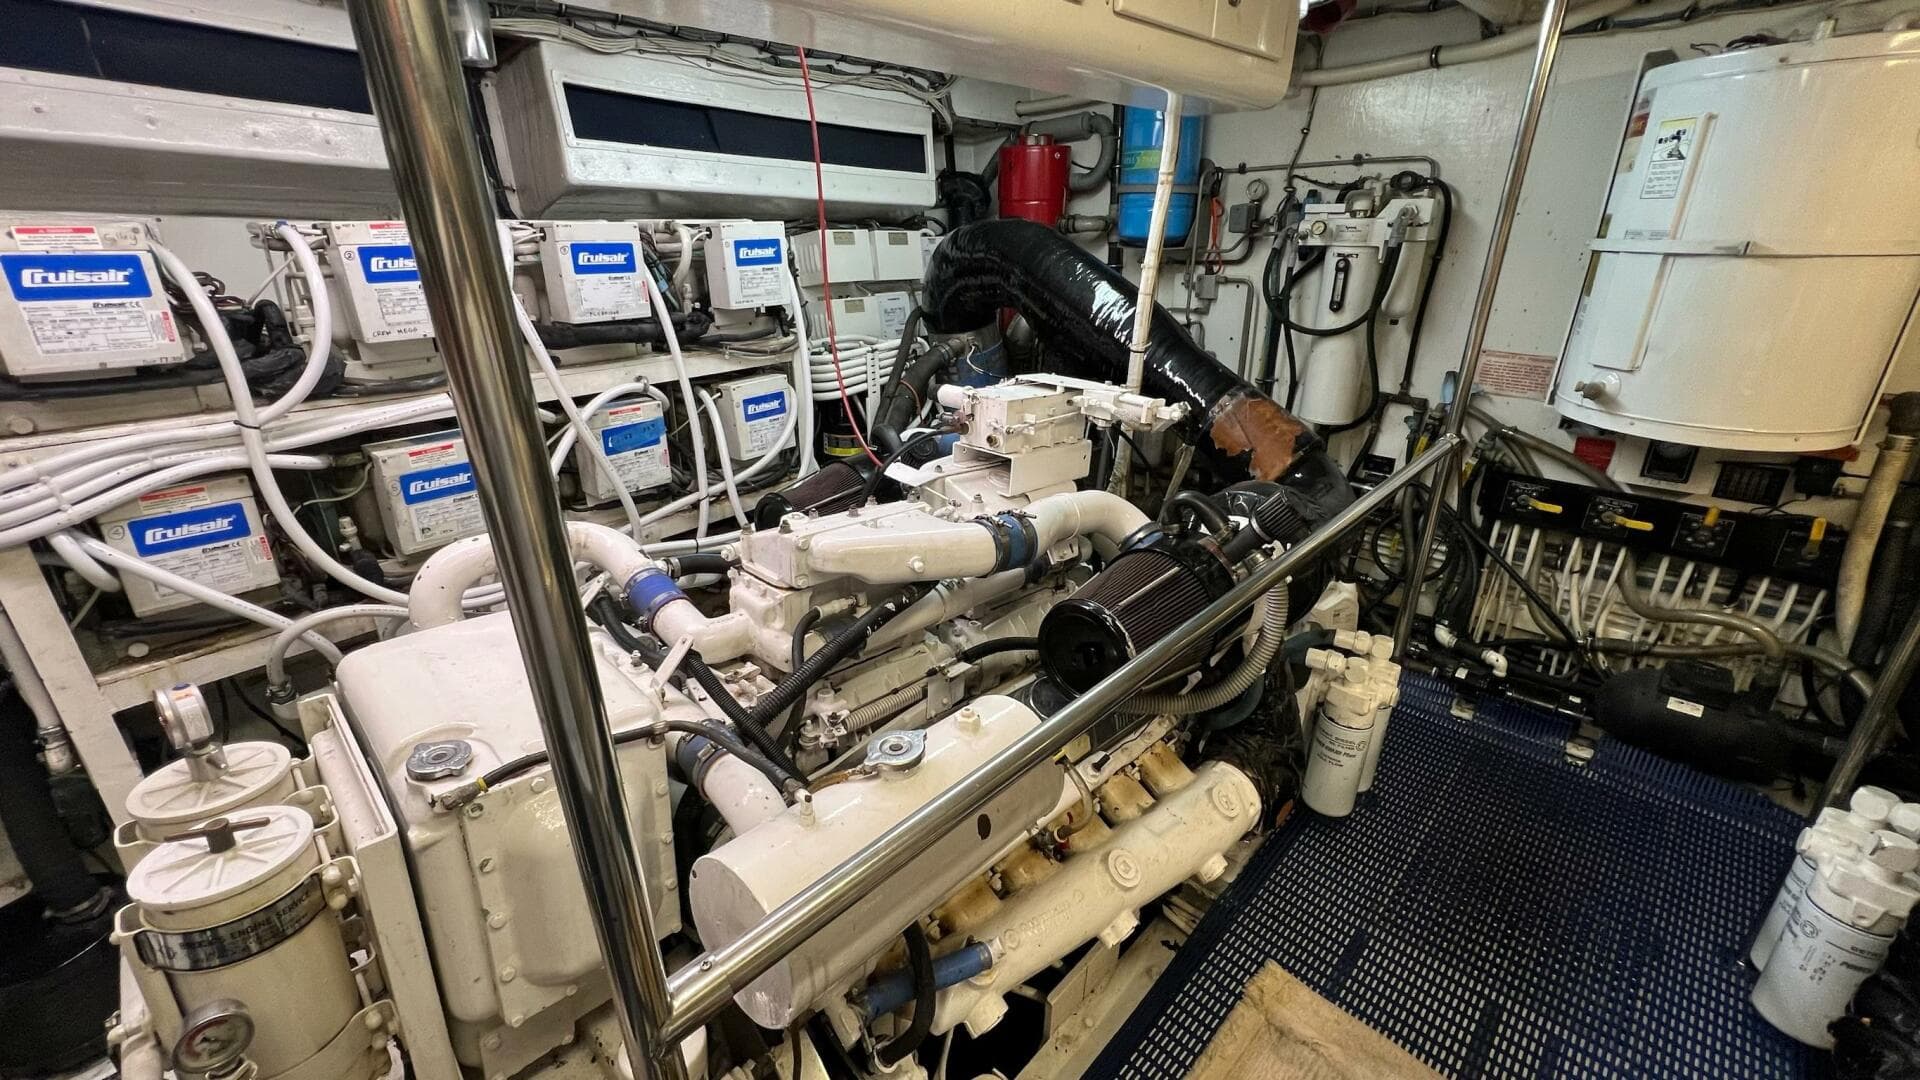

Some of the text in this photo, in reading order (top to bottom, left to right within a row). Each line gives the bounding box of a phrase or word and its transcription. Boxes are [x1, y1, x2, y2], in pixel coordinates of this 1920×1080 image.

[578, 251, 627, 266] Cruisair
[740, 246, 776, 259] Cruisair
[371, 257, 416, 273] Cruis
[21, 268, 131, 288] Cruisair
[409, 472, 472, 495] Cruisair
[144, 516, 233, 545] Cruisair
